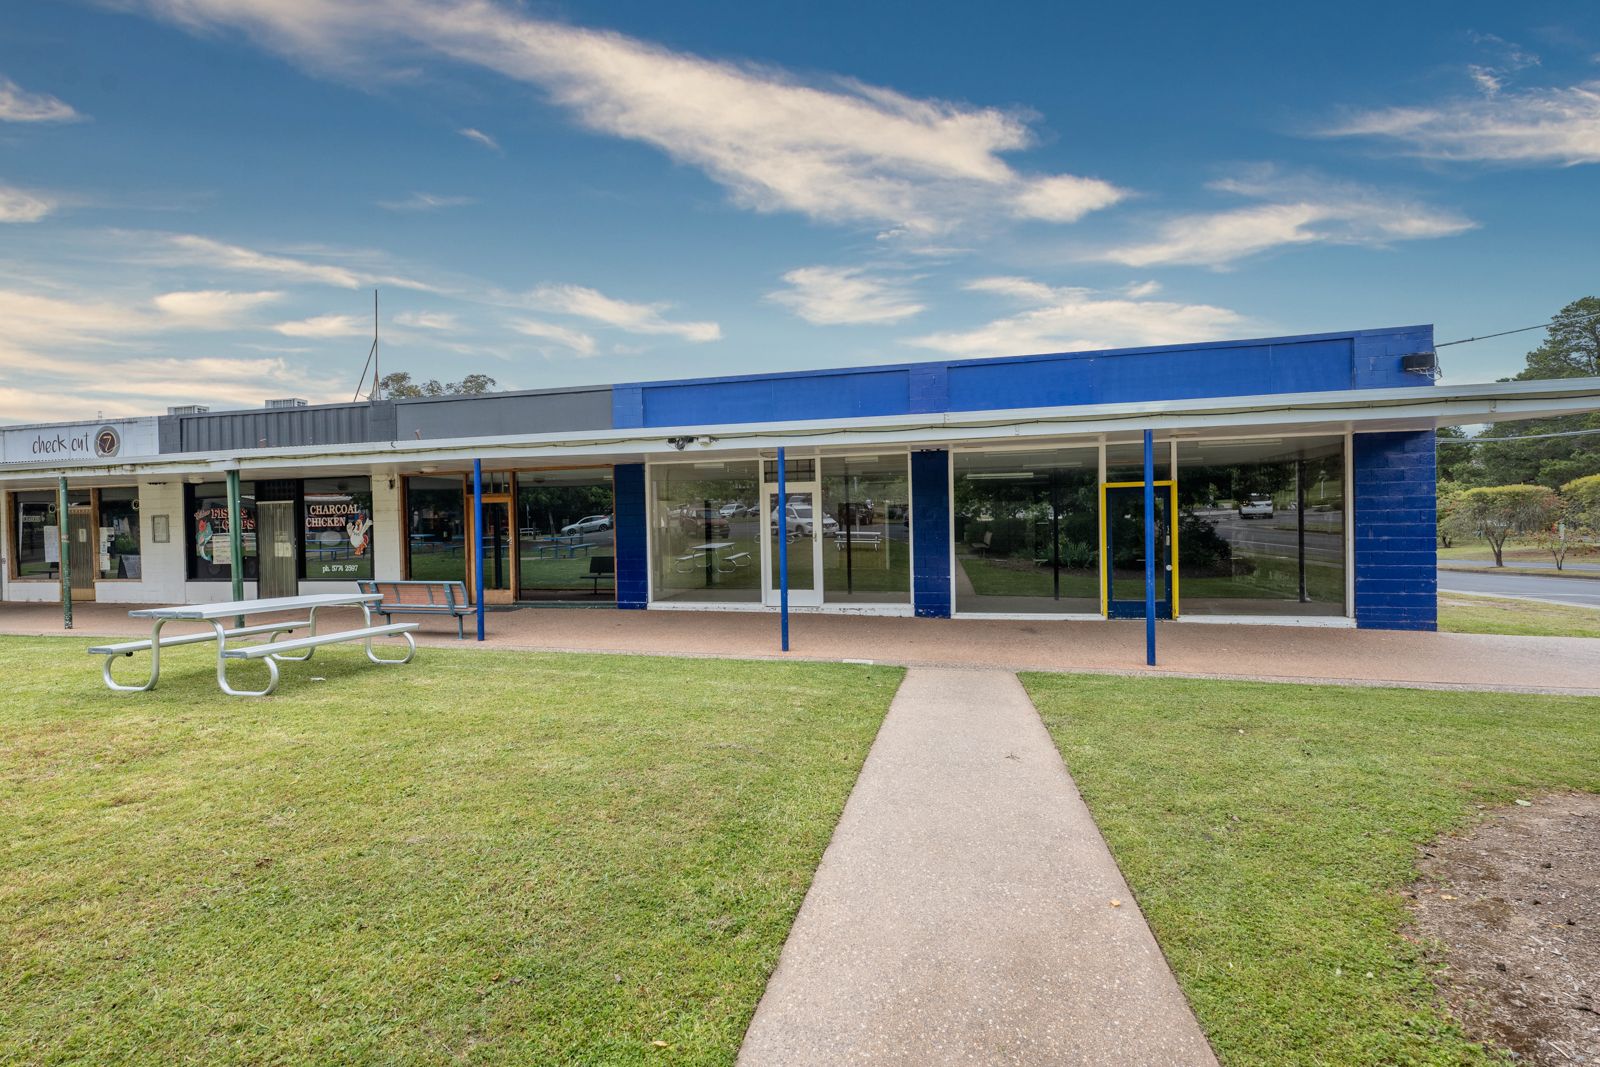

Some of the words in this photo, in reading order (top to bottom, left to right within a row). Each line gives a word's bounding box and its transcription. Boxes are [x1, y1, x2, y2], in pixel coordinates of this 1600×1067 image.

[32, 433, 67, 454] check
[103, 435, 112, 453] 7
[211, 508, 236, 519] FIS
[309, 503, 360, 515] CHARCOAL
[222, 519, 256, 531] CPS
[305, 516, 346, 528] CHICKEN
